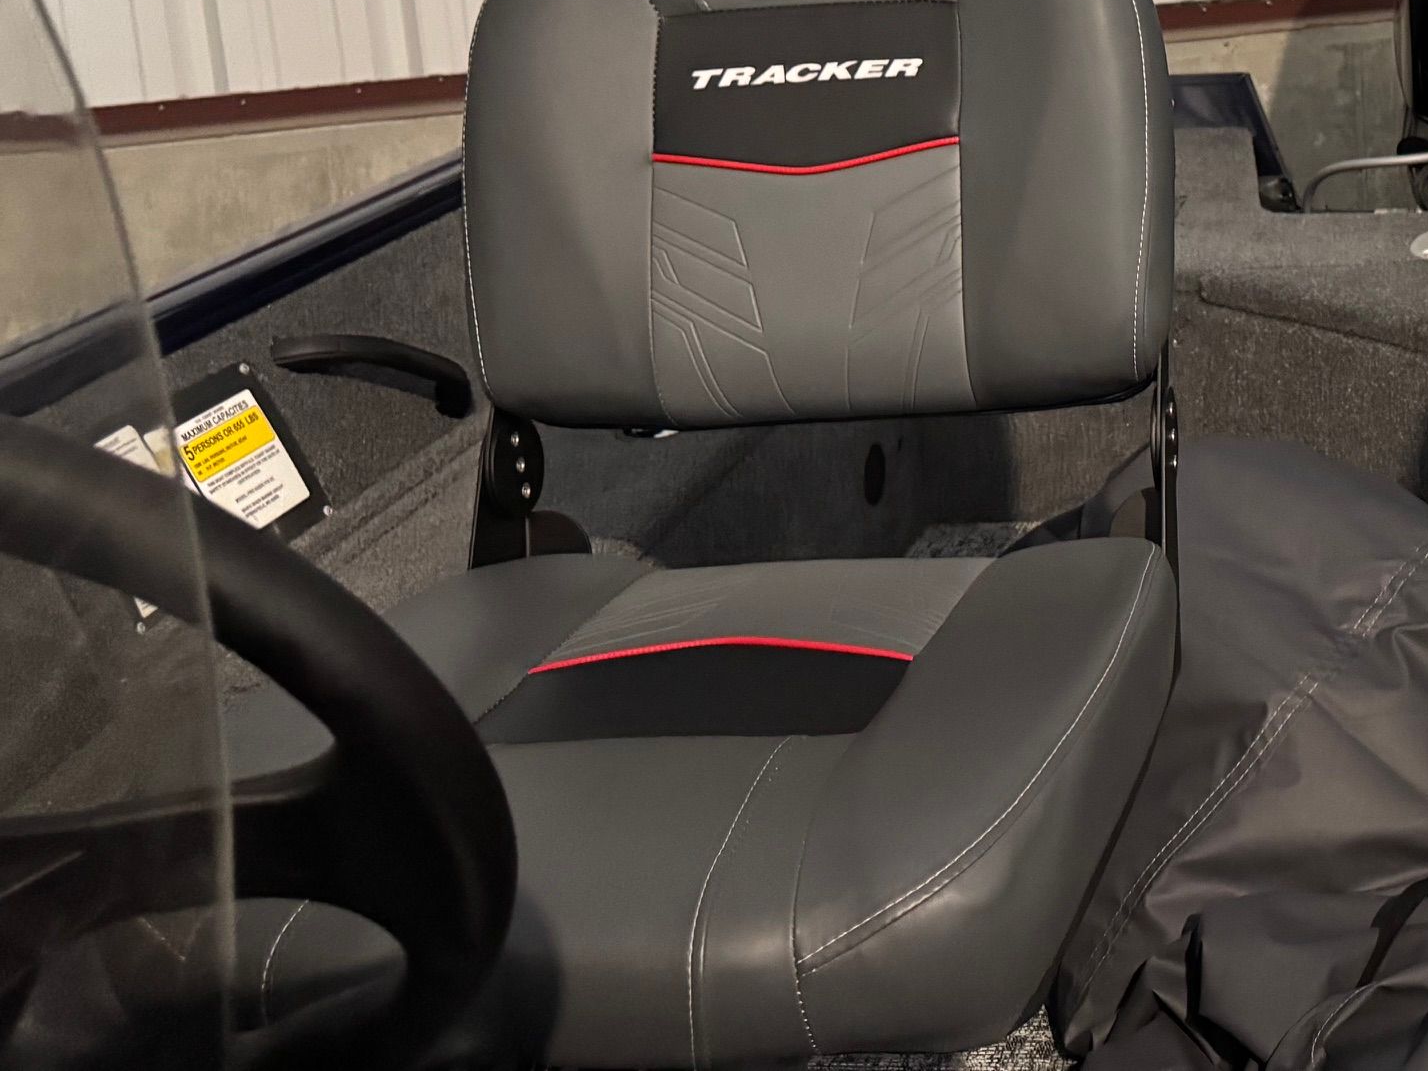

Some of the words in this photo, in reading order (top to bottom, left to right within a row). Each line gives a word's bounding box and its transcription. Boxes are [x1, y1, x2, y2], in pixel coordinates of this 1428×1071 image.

[691, 58, 923, 90] TRACKER
[181, 419, 213, 441] MAXIMUM
[212, 400, 249, 424] CAPACITIES
[183, 445, 195, 461] 5
[192, 432, 224, 455] PERSONS
[222, 425, 234, 437] OR
